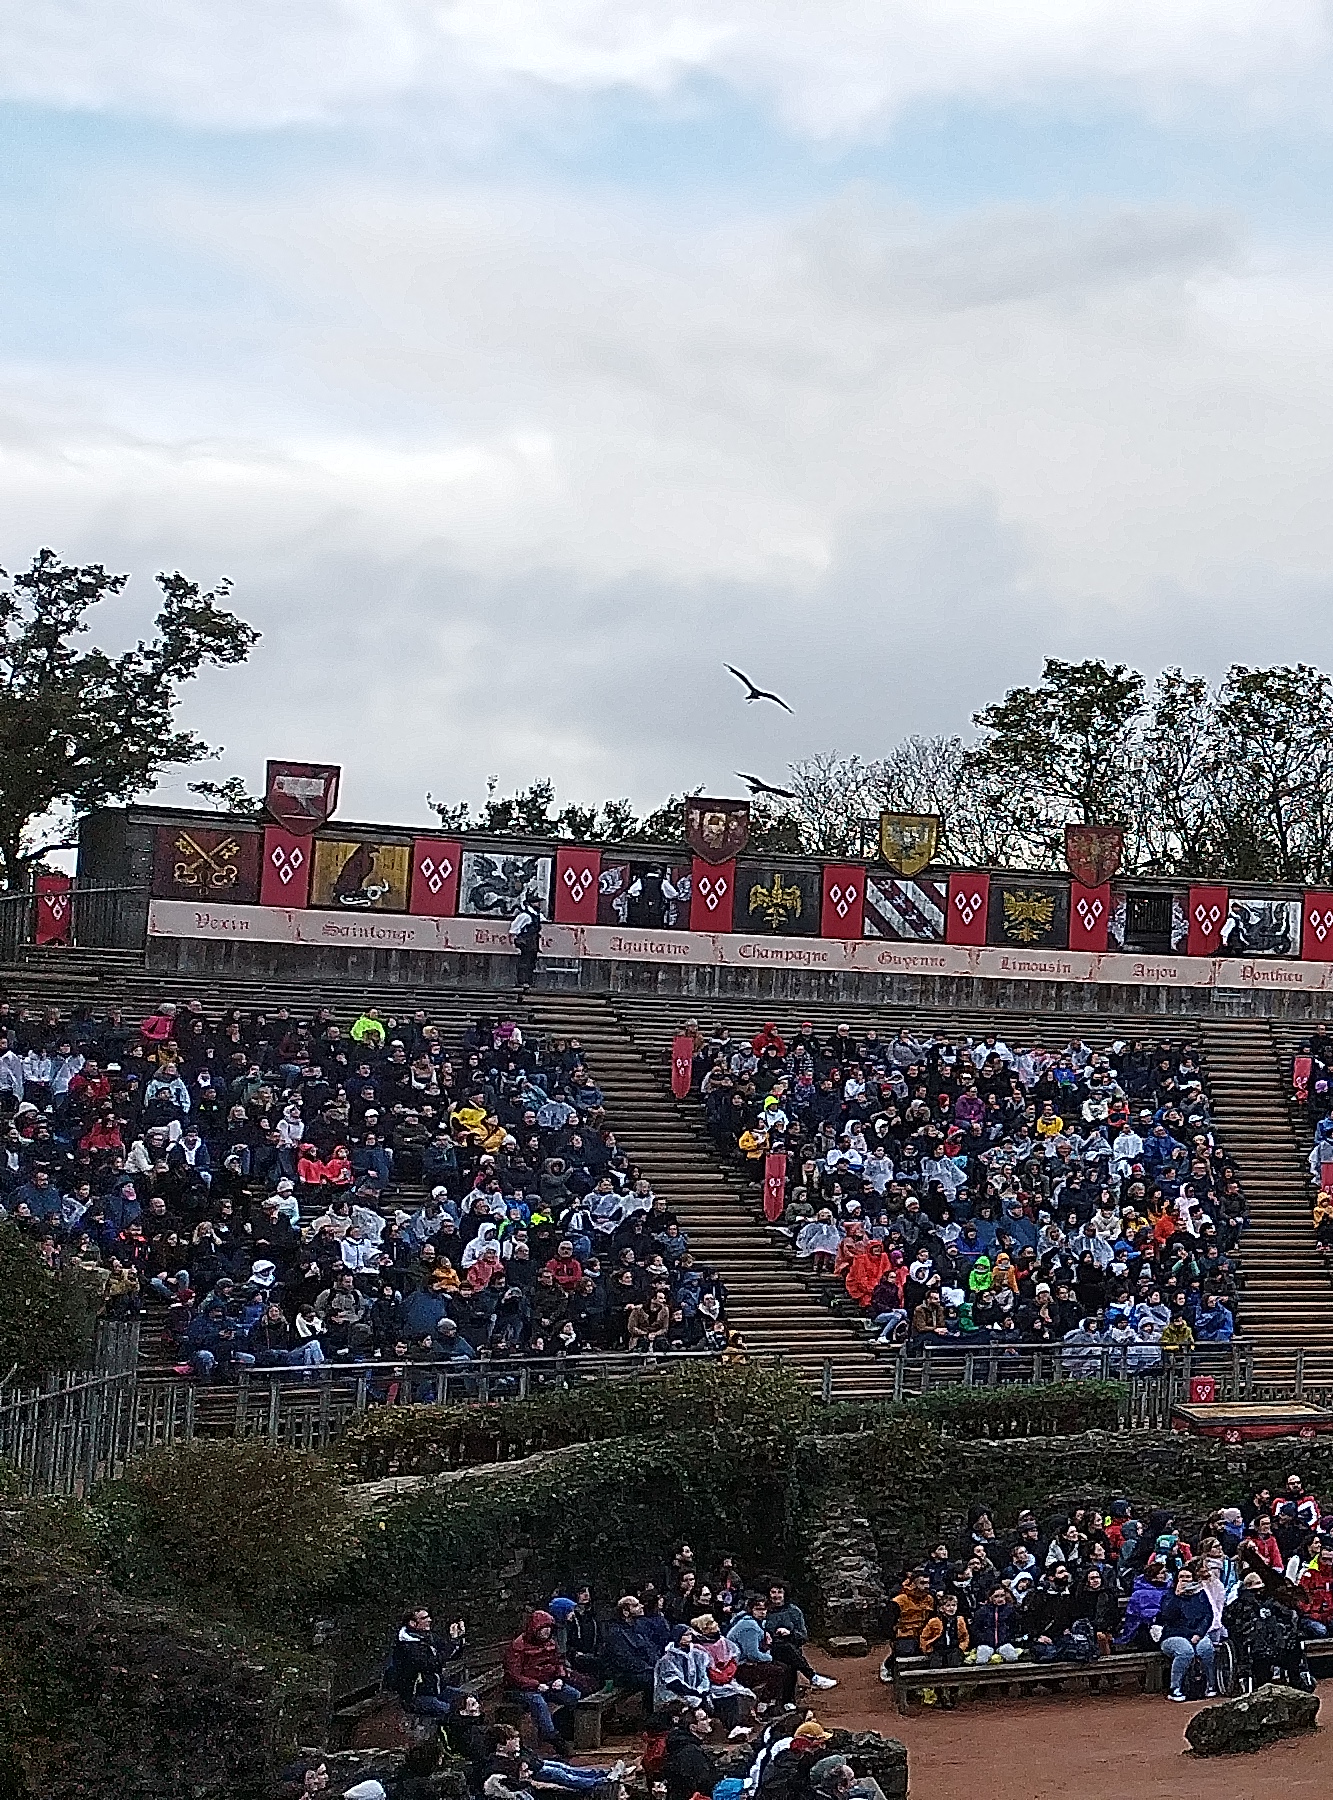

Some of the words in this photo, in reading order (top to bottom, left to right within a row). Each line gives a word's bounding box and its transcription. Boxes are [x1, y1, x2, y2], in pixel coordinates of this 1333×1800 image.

[194, 912, 250, 931] Vexin
[321, 920, 415, 946] Saintonge
[475, 928, 554, 949] Brete
[610, 936, 690, 956] Aquitaine
[738, 943, 829, 966] Champagne
[877, 950, 946, 970] Guyenne
[1000, 956, 1071, 974] Limousin
[1132, 963, 1178, 981] Anjou
[1240, 962, 1303, 986] Ponthieu
